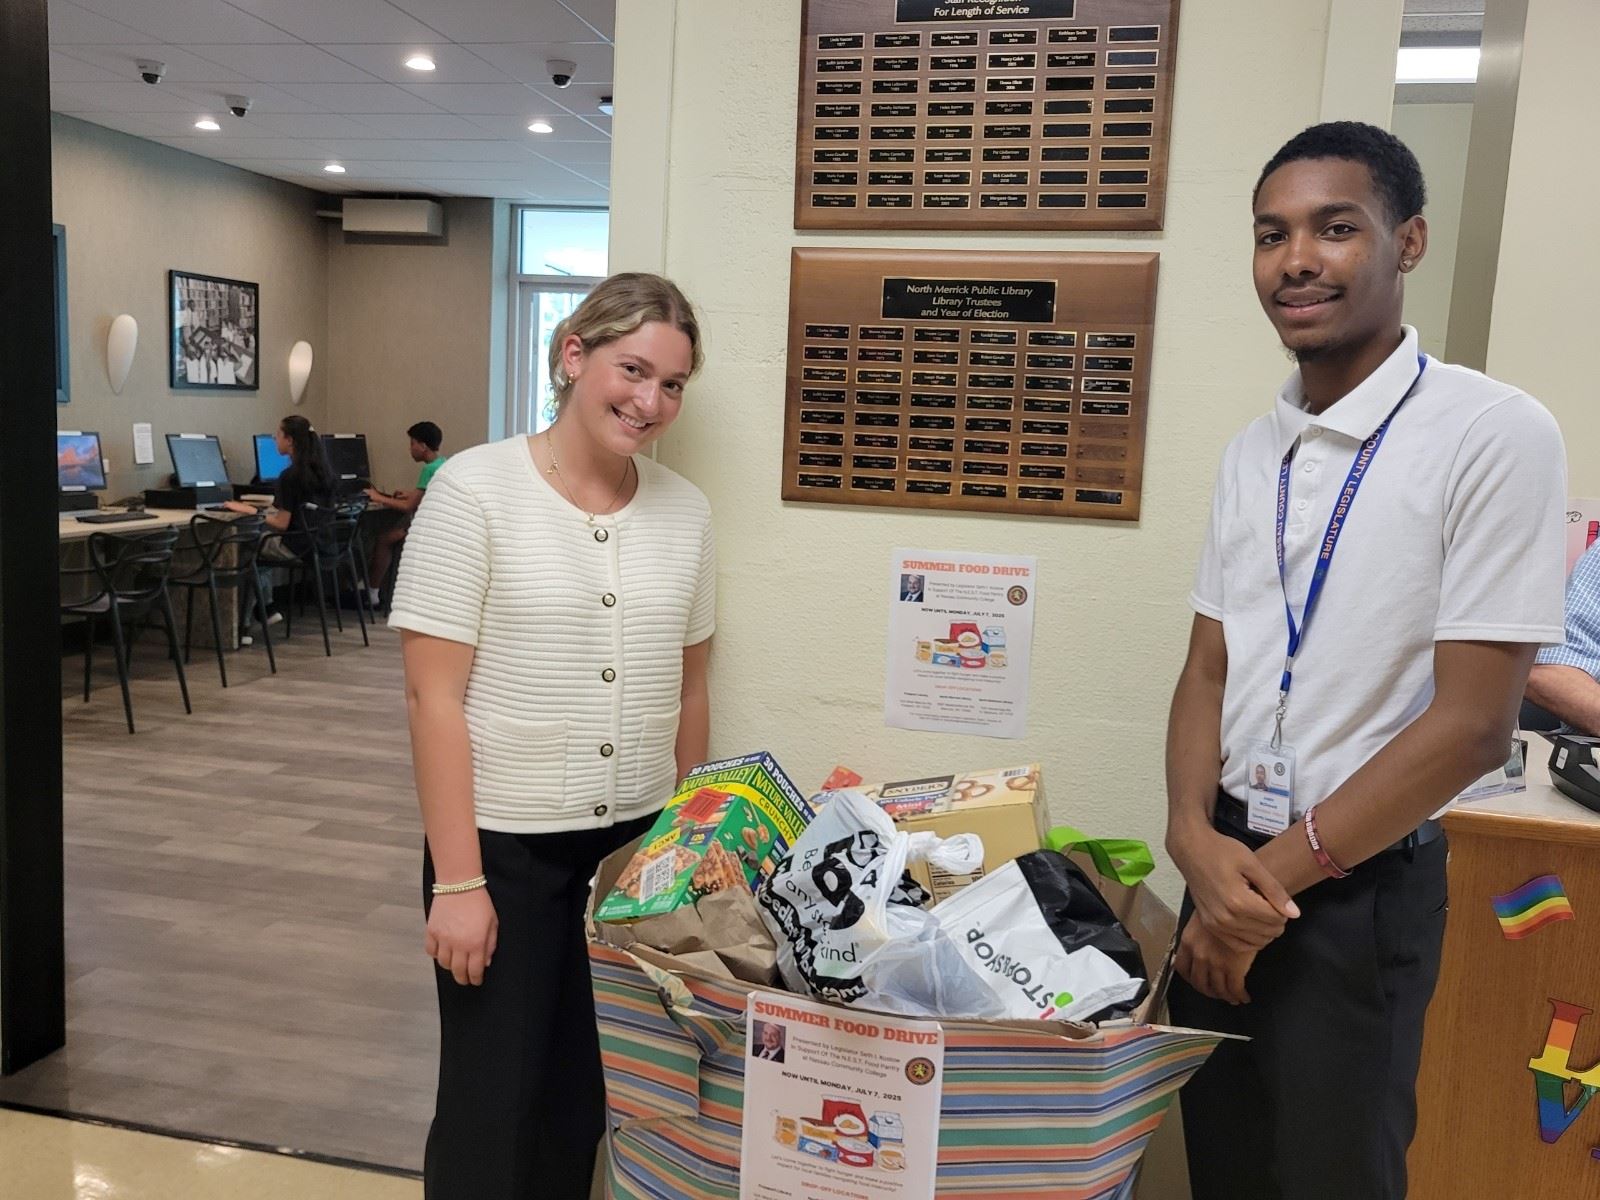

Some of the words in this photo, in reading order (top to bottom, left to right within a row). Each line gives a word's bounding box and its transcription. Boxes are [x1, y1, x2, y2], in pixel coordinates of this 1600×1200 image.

[934, 8, 949, 17] For
[951, 6, 981, 18] Length
[984, 6, 994, 15] of
[996, 5, 1030, 15] Service
[906, 284, 932, 294] North
[934, 285, 969, 295] Merrick
[971, 285, 1000, 295] Public
[1001, 286, 1033, 298] Library
[932, 297, 963, 308] Library
[966, 297, 1002, 307] Trustees
[920, 308, 938, 317] and
[940, 308, 960, 318] Year
[962, 308, 972, 318] of
[974, 309, 1009, 319] Election
[1353, 432, 1380, 479] COUNTY
[1277, 477, 1288, 521] COUNTY
[1321, 481, 1357, 560] LEGISLATURE
[902, 560, 957, 573] SUMMER
[959, 564, 989, 575] FOOD
[992, 566, 1030, 577] DRIVE
[676, 774, 718, 795] NATURE
[718, 766, 755, 782] VALLEY
[701, 757, 744, 774] POUCHES
[763, 756, 774, 771] 30
[772, 768, 805, 811] POUCHES
[752, 770, 786, 811] NATURE
[783, 807, 807, 838] VALLE
[759, 798, 794, 842] CRUNCHY
[785, 879, 817, 911] any
[754, 1001, 830, 1029] SUMMER
[834, 1018, 879, 1038] FOOD
[883, 1026, 938, 1045] DRIVE
[798, 1045, 819, 1056] Support
[829, 1052, 840, 1060] The
[864, 1058, 879, 1068] Food
[781, 1071, 798, 1079] NOW
[799, 1074, 819, 1085] UNTIL
[855, 1087, 872, 1097] JULY
[883, 1093, 902, 1103] 2025
